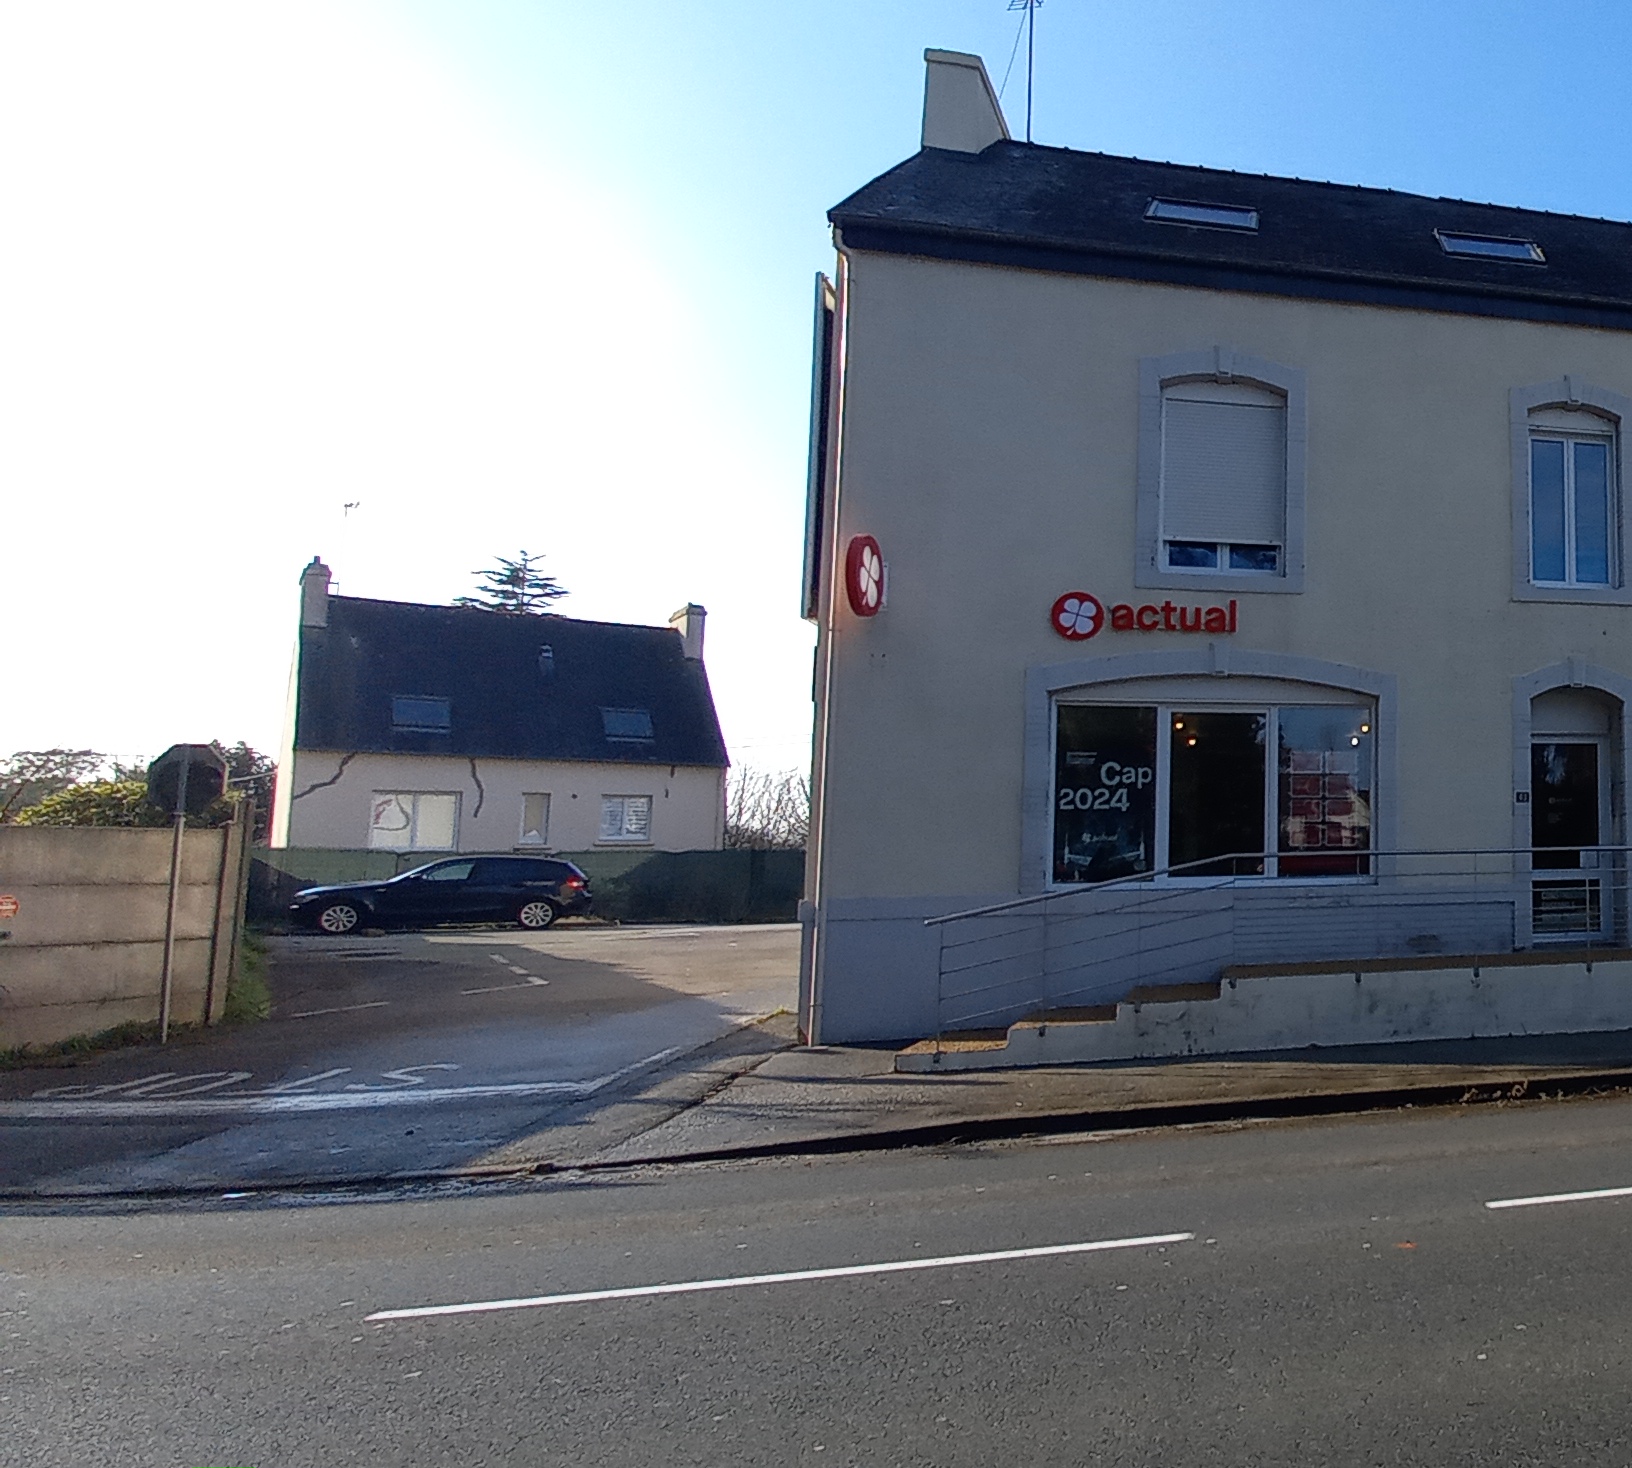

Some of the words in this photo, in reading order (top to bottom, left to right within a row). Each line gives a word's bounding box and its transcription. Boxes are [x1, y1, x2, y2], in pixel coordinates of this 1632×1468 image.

[1111, 600, 1237, 633] actual
[1100, 761, 1153, 789] Cap
[1059, 788, 1130, 811] 2024
